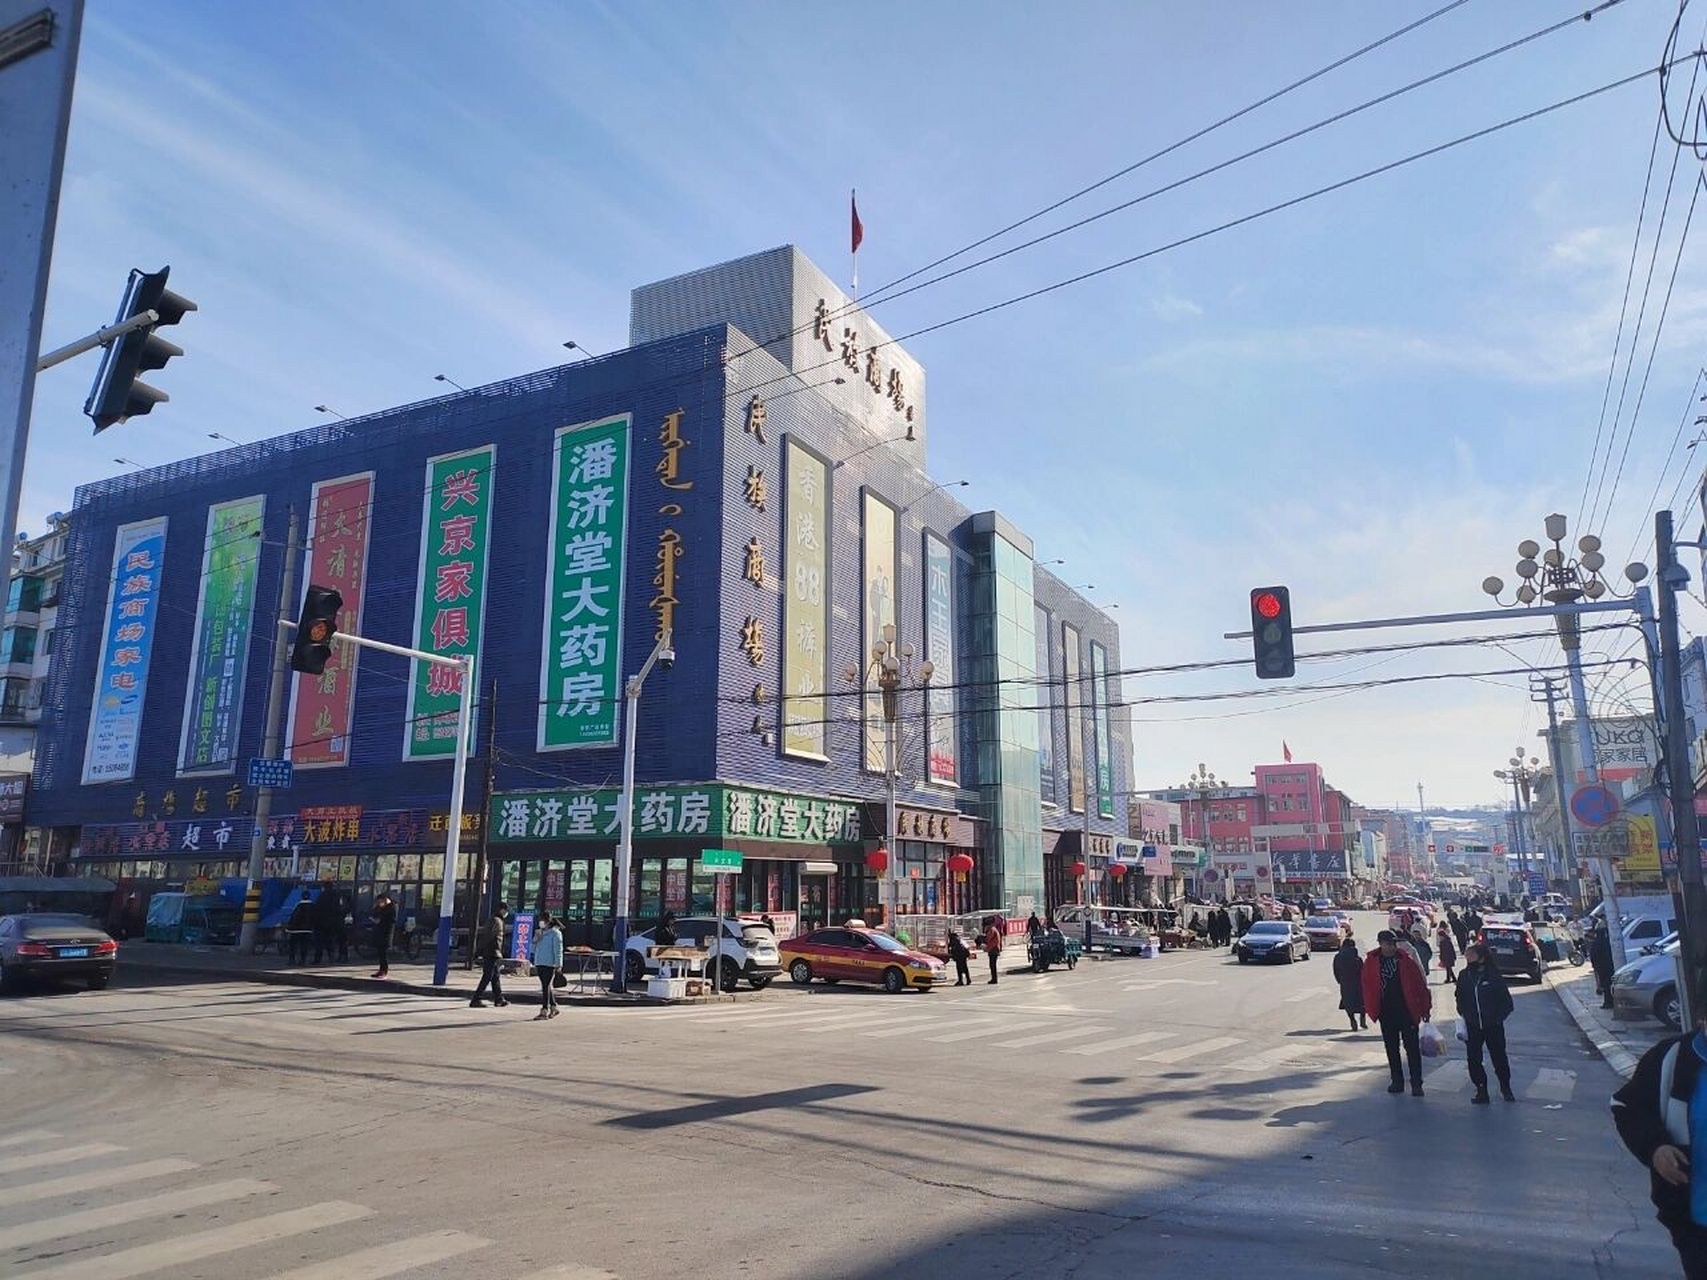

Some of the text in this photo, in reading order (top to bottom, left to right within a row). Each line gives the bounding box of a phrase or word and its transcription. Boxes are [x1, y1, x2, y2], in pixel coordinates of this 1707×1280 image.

[110, 550, 155, 691] 民族商场家电
[426, 469, 480, 697] 兴京家俱城
[556, 437, 617, 719] 潘济堂大药房
[181, 821, 234, 851] 超市
[499, 791, 712, 838] 潘济堂大药房
[727, 791, 861, 842] 潘济堂大药房
